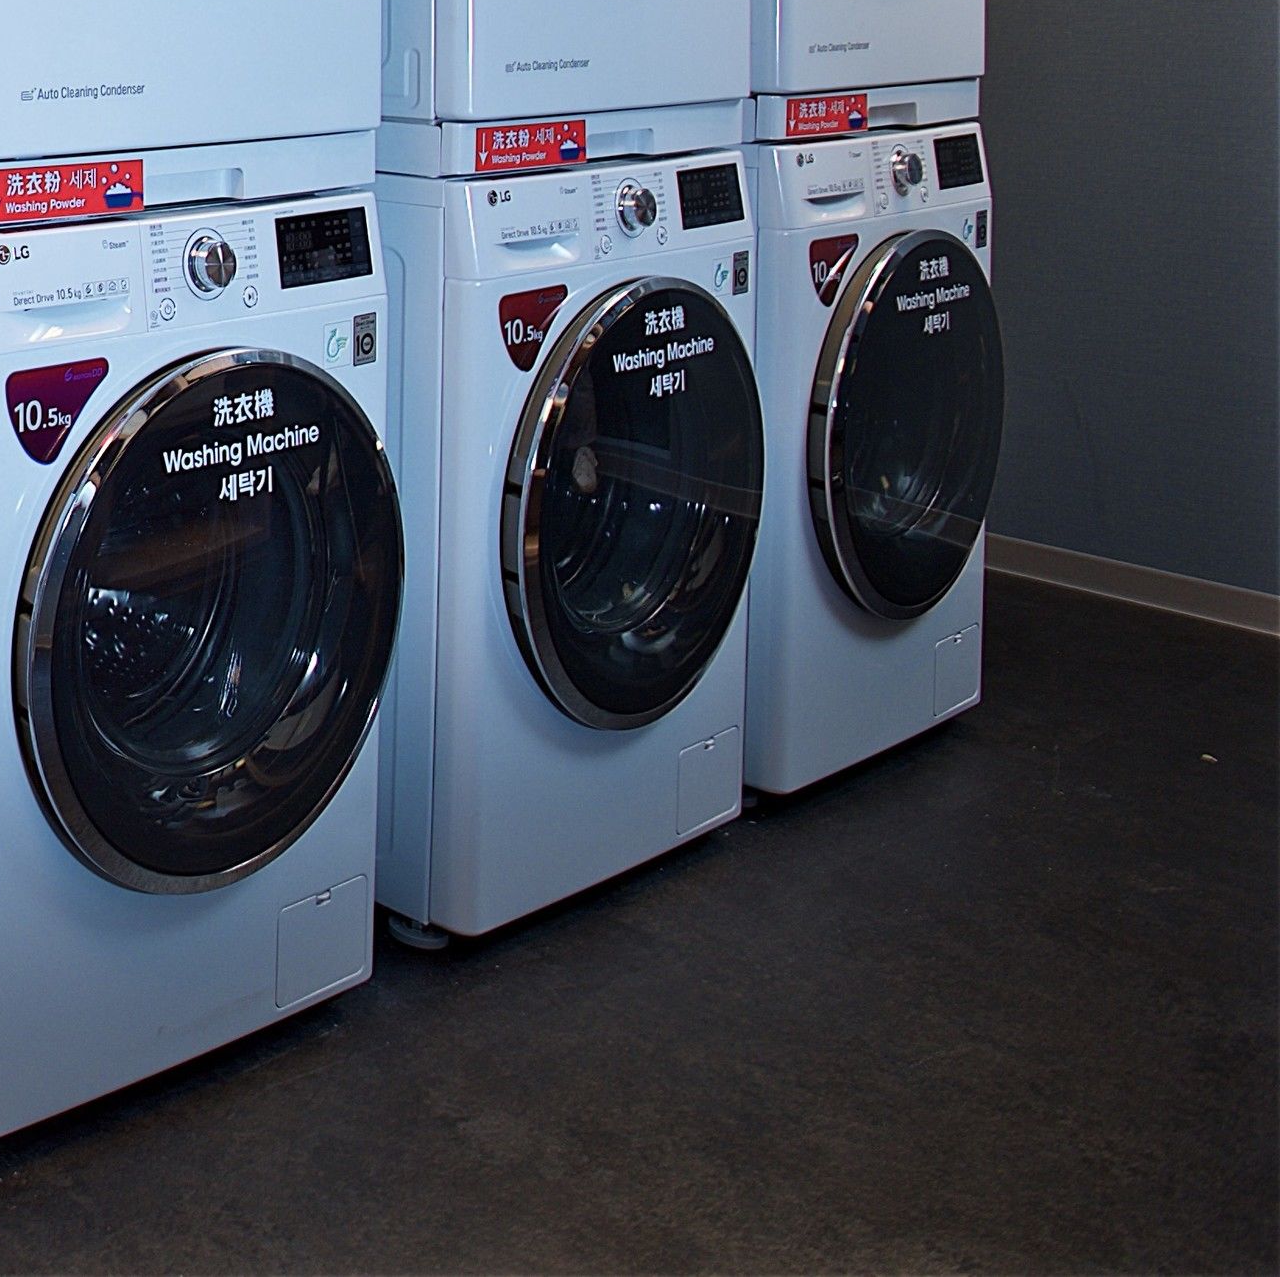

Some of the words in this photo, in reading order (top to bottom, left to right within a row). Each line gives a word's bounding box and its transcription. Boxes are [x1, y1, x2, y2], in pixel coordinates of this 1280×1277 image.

[517, 60, 531, 72] Auto
[532, 58, 558, 72] Cleaning
[559, 57, 590, 70] Condenser
[37, 88, 59, 100] Auto
[61, 86, 99, 100] Cleaning
[100, 84, 146, 96] Condenser
[491, 129, 530, 150] 洗衣粉
[491, 153, 520, 165] Washing
[521, 150, 547, 162] Powder
[6, 170, 61, 197] 洗衣粉
[500, 190, 511, 202] LG
[5, 200, 48, 214] Washing
[50, 197, 85, 210] Powder
[13, 245, 30, 261] LG
[13, 295, 35, 307] Direct
[36, 292, 54, 303] Drive
[897, 293, 935, 312] Washing
[936, 283, 970, 304] Machine
[504, 319, 543, 347] 10.5kg
[645, 305, 685, 336] 洗衣機
[612, 348, 665, 374] Washing
[667, 337, 714, 360] Machine
[649, 370, 686, 397] 세탁기
[14, 399, 72, 433] 10.5kg
[213, 388, 274, 427] 洗衣機
[163, 441, 241, 474] Washing
[247, 424, 319, 456] Machine
[219, 466, 273, 501] 세탁기
